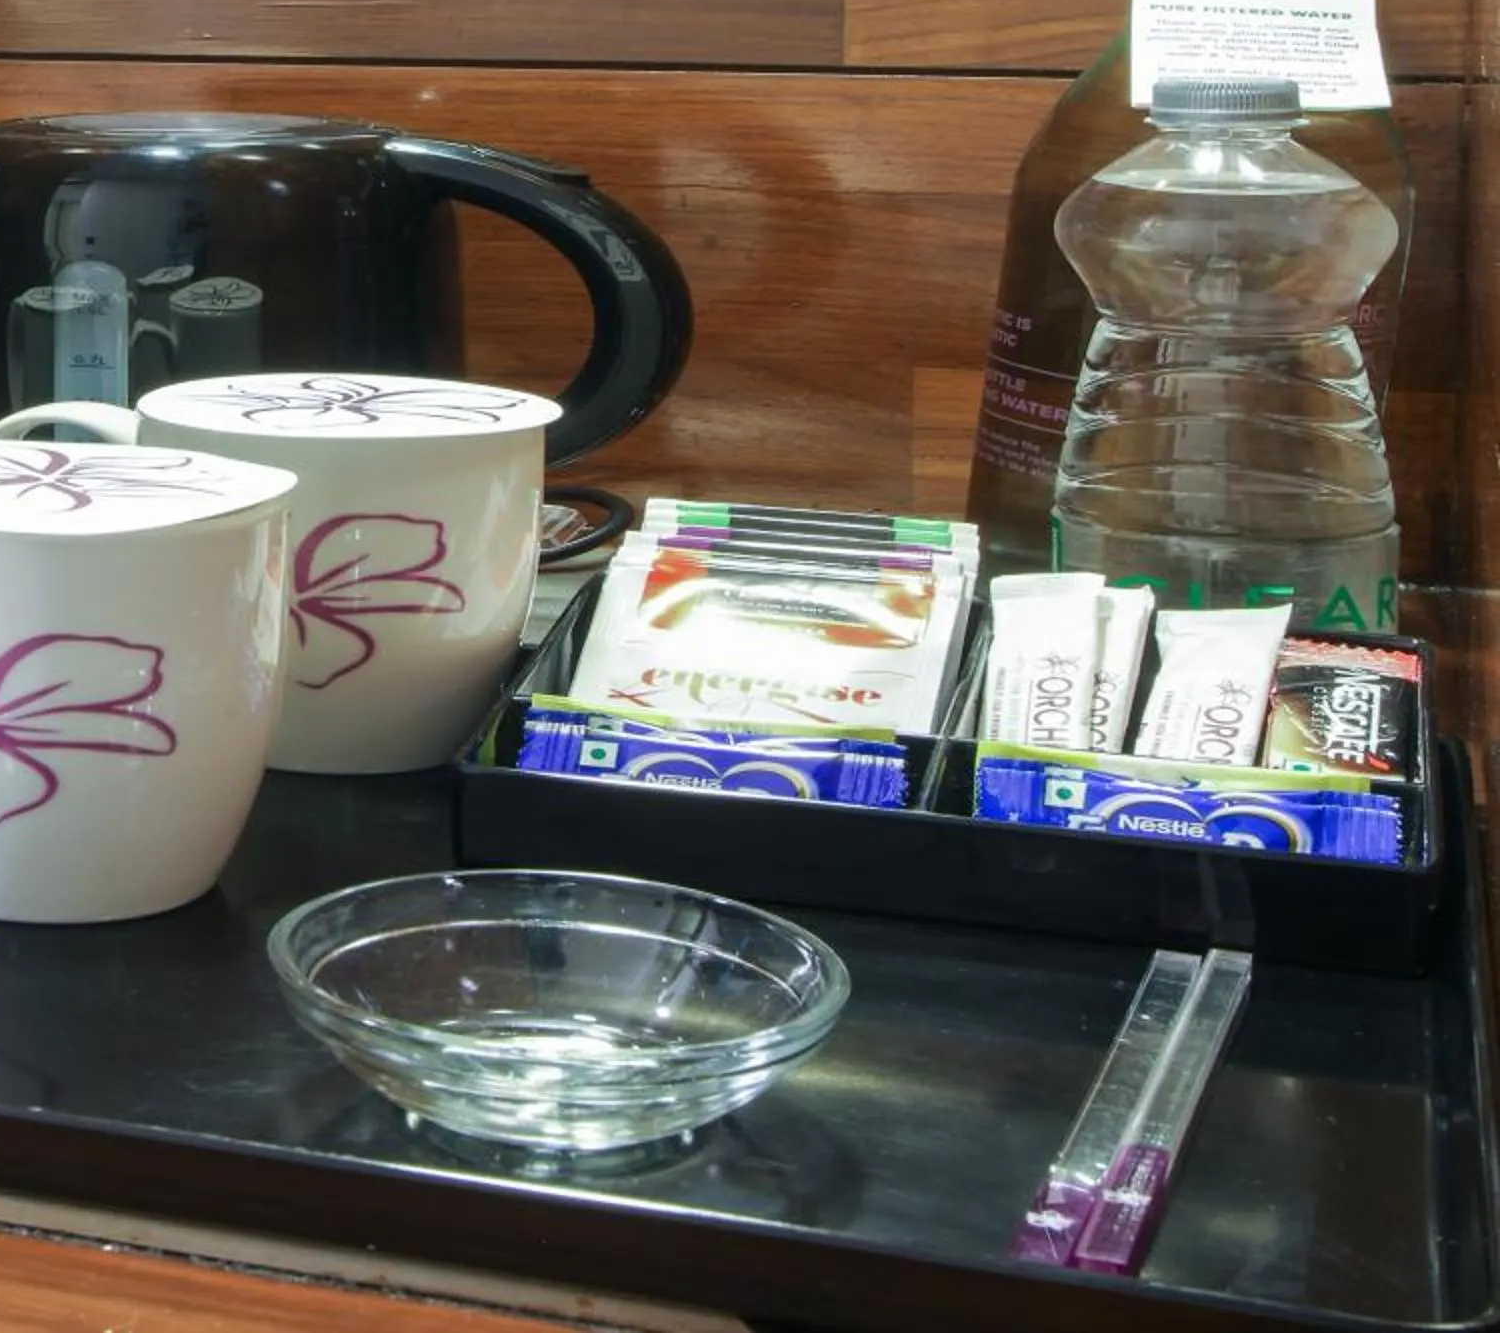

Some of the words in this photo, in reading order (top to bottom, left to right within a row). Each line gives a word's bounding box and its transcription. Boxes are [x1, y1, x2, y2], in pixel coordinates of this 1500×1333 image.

[1203, 5, 1284, 17] FILTERED
[1291, 10, 1352, 21] WATER
[1001, 393, 1068, 422] WATER
